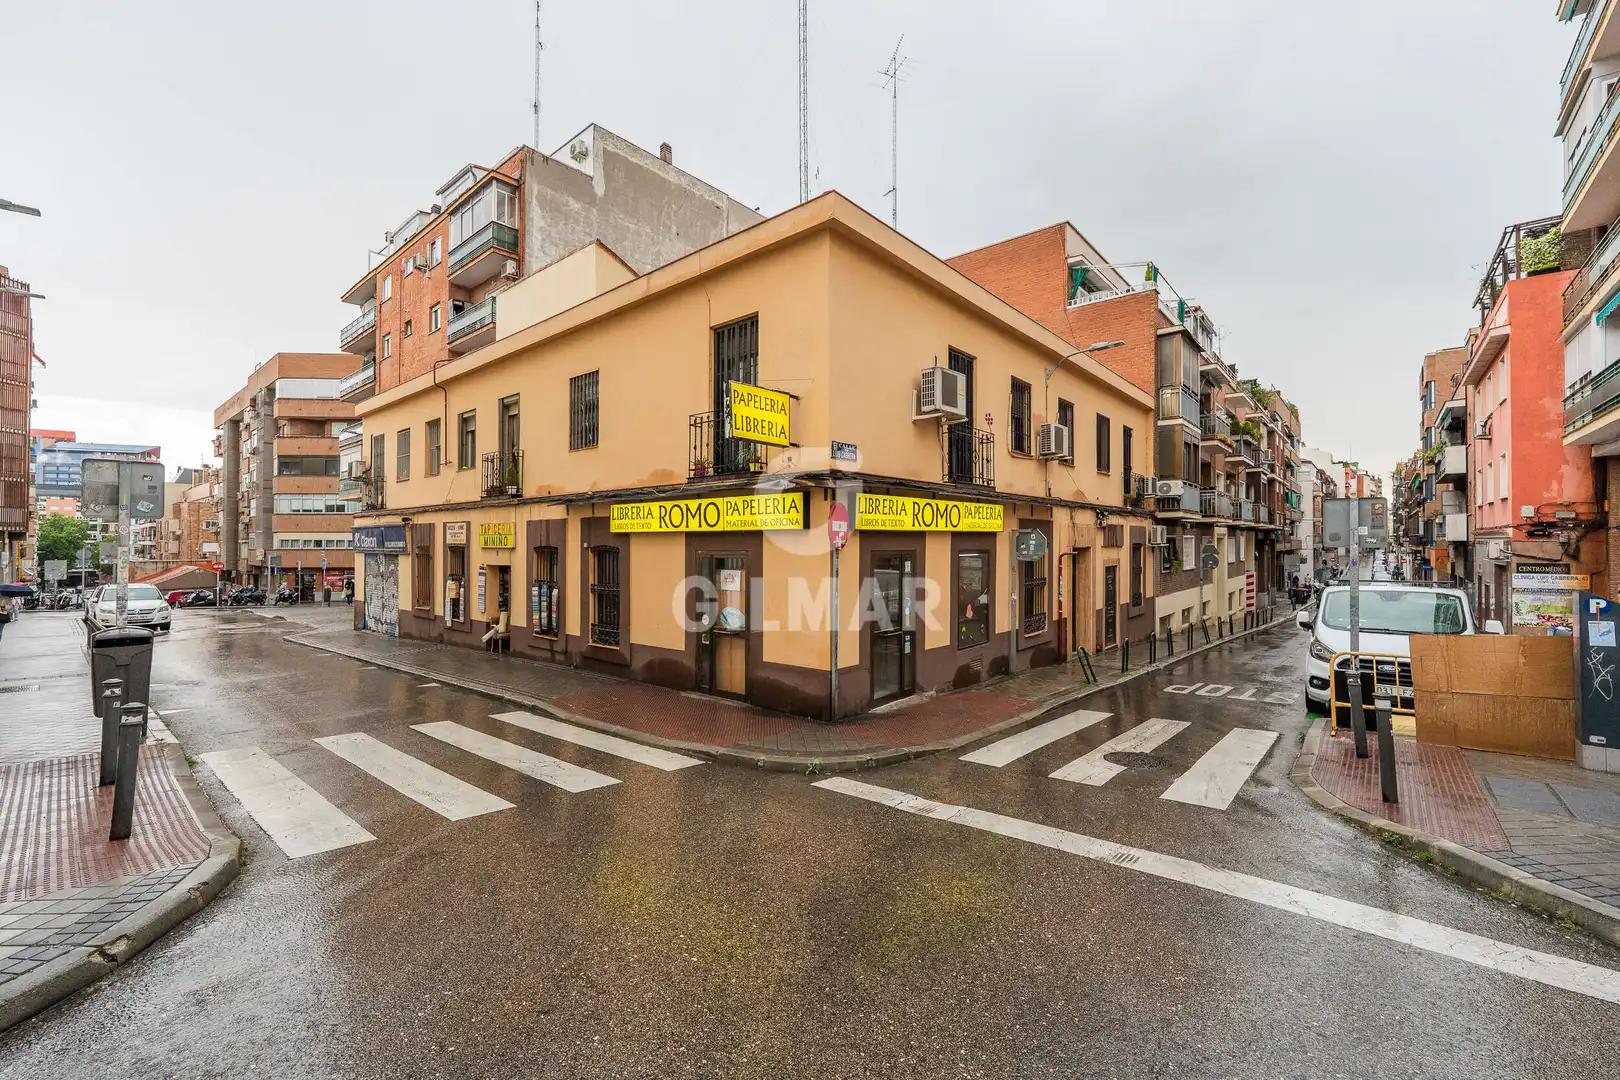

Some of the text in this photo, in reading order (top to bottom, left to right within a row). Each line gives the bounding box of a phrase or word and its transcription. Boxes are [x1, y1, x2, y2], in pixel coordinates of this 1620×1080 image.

[733, 389, 787, 416] PAPELERIA
[734, 413, 787, 440] LIBRERIA
[612, 497, 800, 529] LIBRERIA ROMO PAPELERIA
[636, 522, 652, 530] TEXTO
[726, 519, 758, 528] MATERIAL
[760, 518, 768, 527] DE
[770, 517, 801, 527] OFICINA
[858, 497, 1002, 528] LIBRERIA ROMO PAPELERIA
[861, 518, 879, 527] LIBROS
[881, 518, 887, 527] DE
[888, 518, 905, 528] TEXTO
[1589, 599, 1607, 613] P
